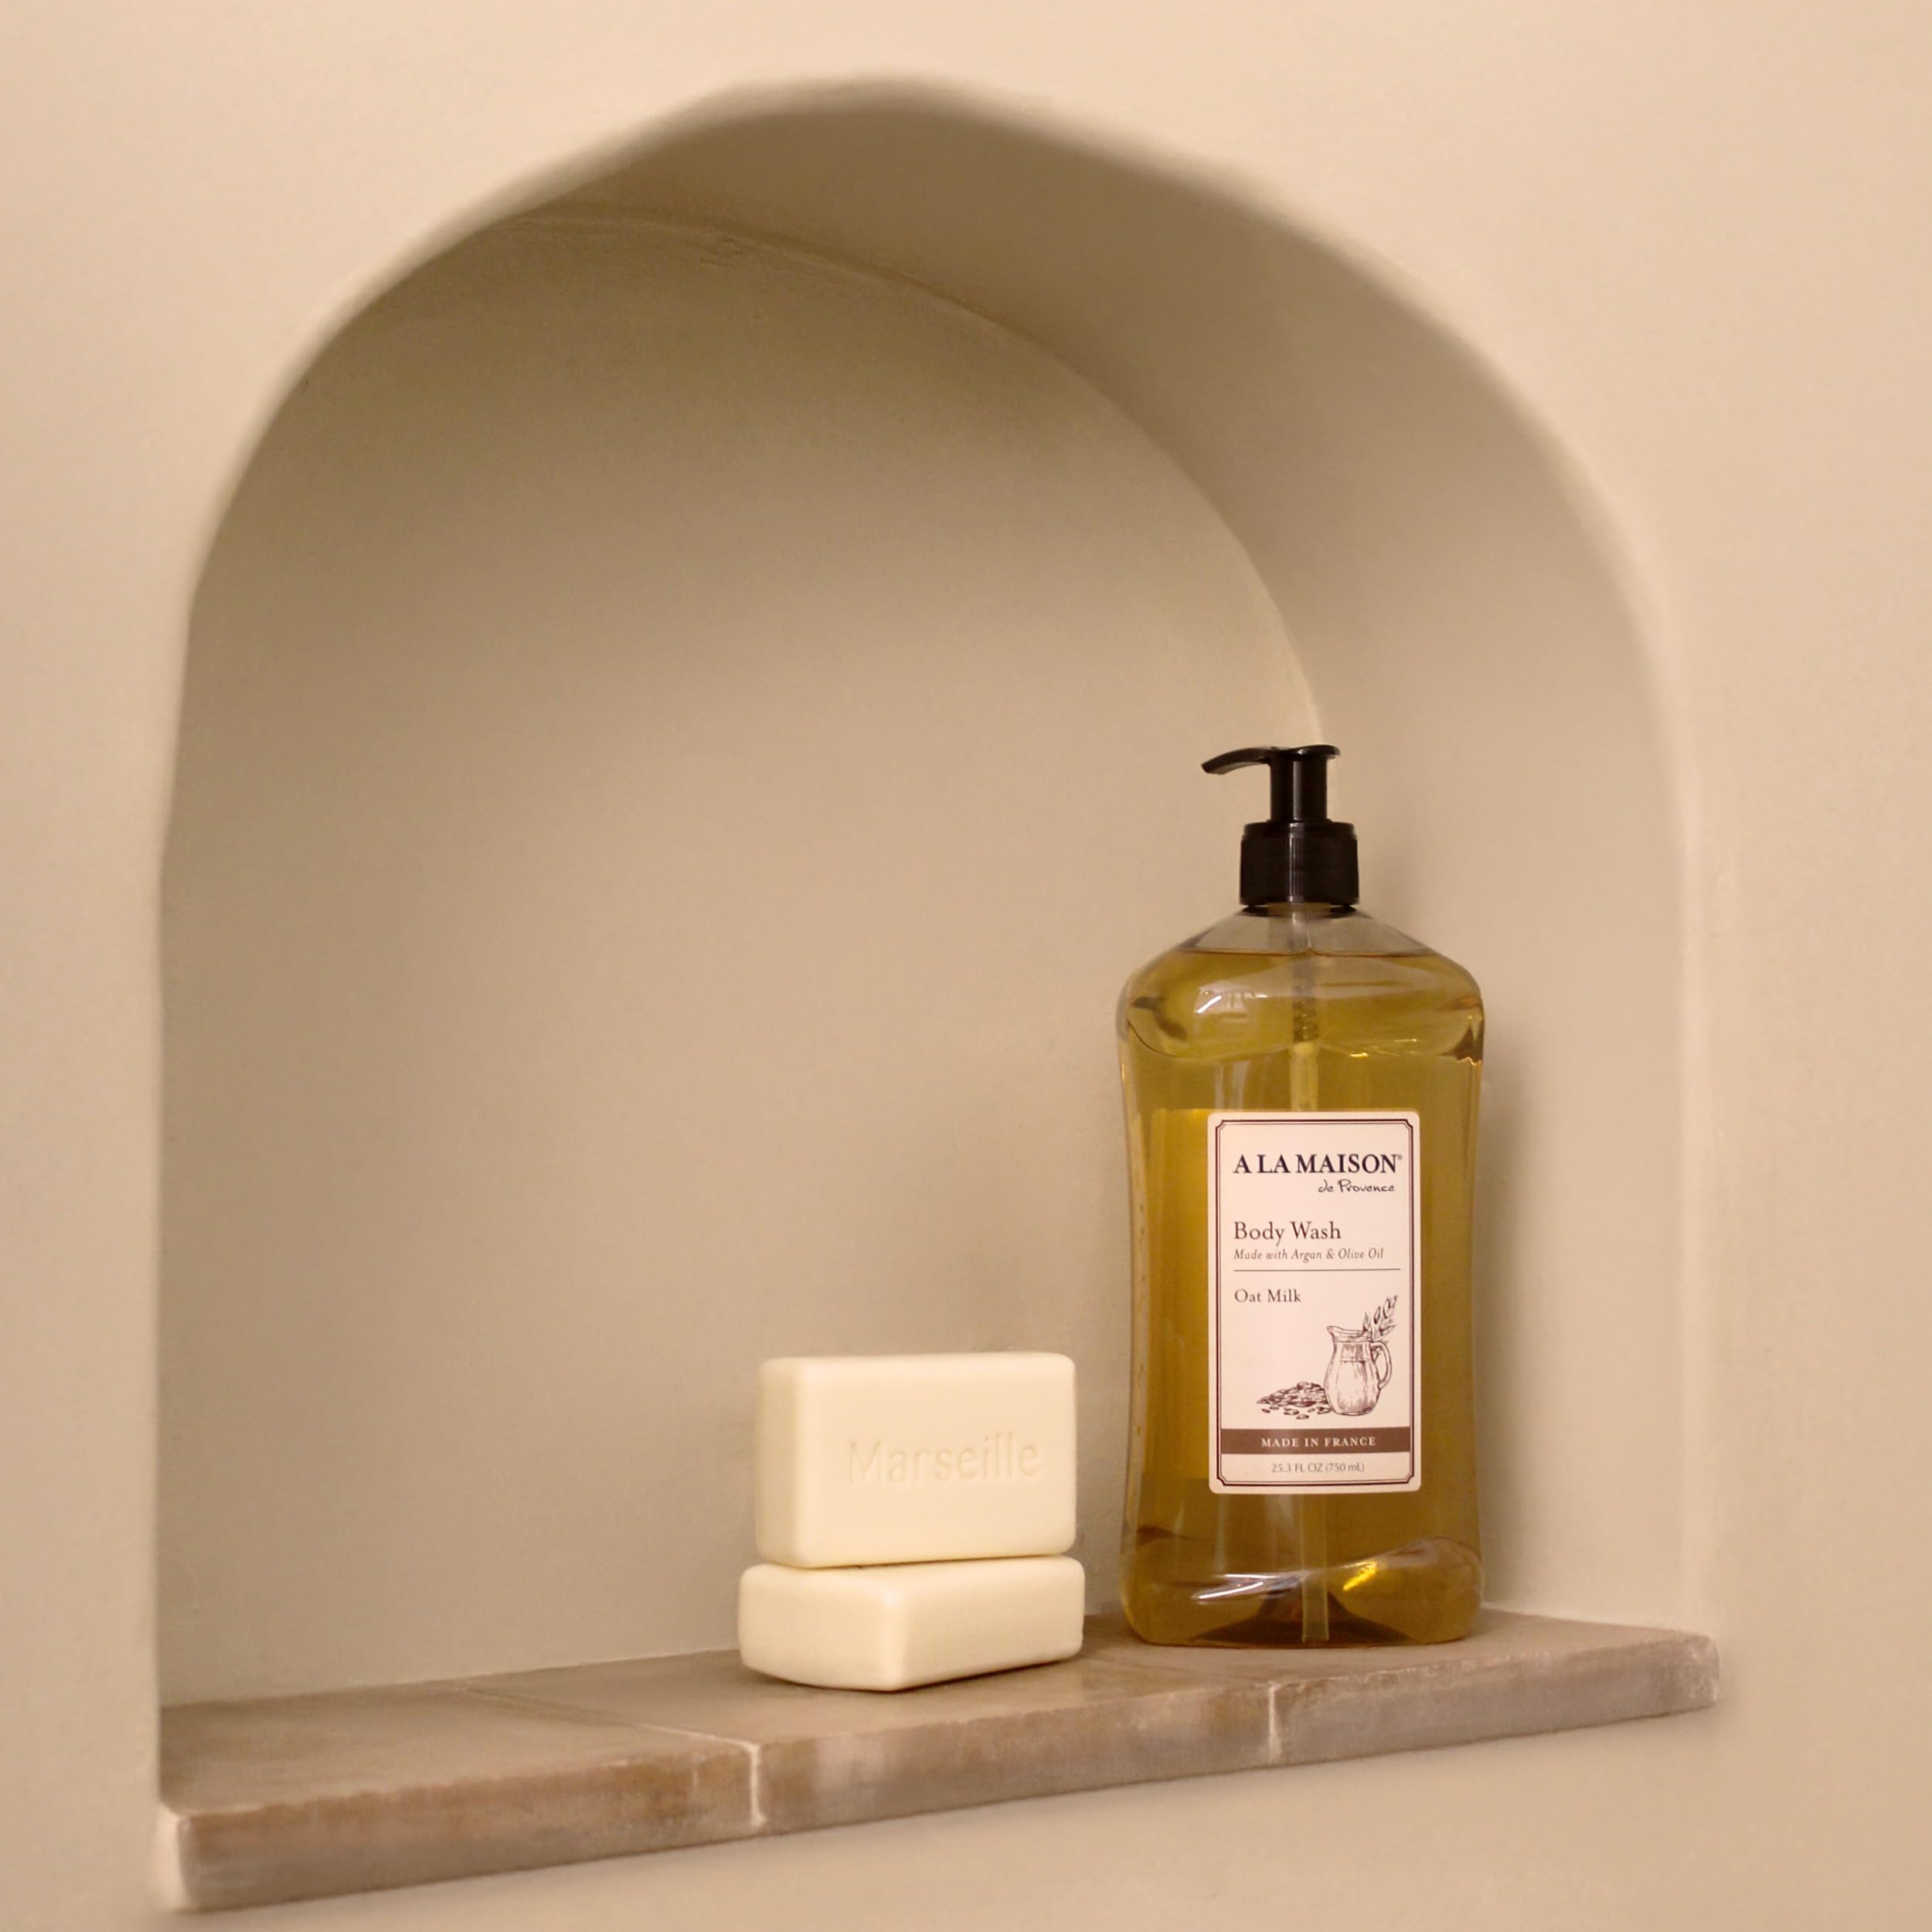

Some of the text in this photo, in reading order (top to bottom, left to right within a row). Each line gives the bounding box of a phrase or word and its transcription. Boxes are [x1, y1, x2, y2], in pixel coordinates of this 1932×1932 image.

[1233, 1155, 1252, 1173] A
[1257, 1155, 1291, 1173] LA
[1318, 1179, 1395, 1193] de Provence
[1234, 1220, 1342, 1247] Body Wash
[1233, 1247, 1384, 1263] Made with Argan & Olive Oil
[1234, 1288, 1301, 1303] Oat Milk
[1261, 1437, 1376, 1447] MADE IN FRANCE
[849, 1431, 1042, 1485] Marseille
[1270, 1463, 1292, 1473] 25.3
[1294, 1463, 1305, 1472] FL
[1308, 1463, 1324, 1472] OZ
[1325, 1463, 1345, 1473] (750
